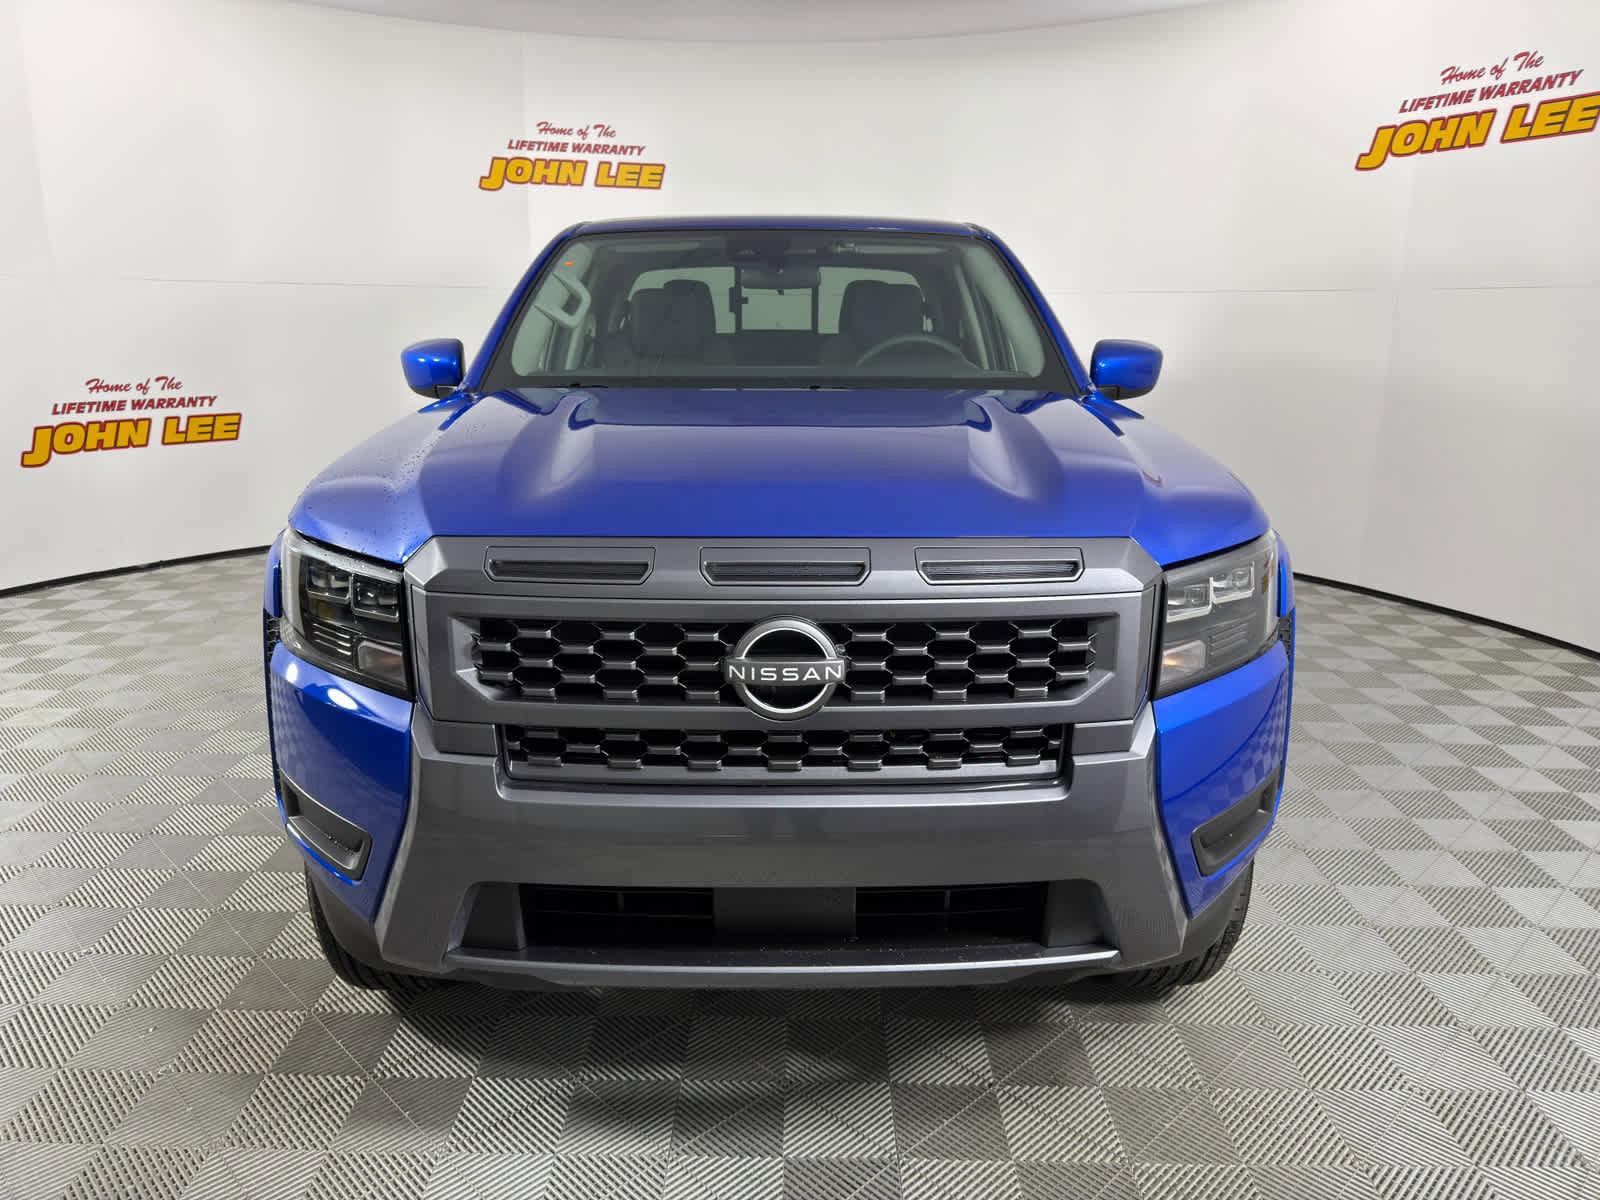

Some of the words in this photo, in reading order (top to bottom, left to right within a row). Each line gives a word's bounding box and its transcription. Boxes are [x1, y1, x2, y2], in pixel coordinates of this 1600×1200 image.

[1440, 66, 1485, 86] Home
[1489, 57, 1509, 80] of
[1513, 50, 1544, 71] The
[1399, 88, 1476, 114] LIFETIME
[1478, 69, 1584, 102] WARRANTY
[536, 121, 573, 136] Home
[577, 126, 589, 140] of
[593, 124, 616, 138] The
[1355, 108, 1497, 171] JOHN
[1500, 91, 1600, 144] LEE
[507, 139, 569, 153] LIFETIME
[572, 142, 646, 156] WARRANTY
[478, 156, 588, 191] JOHN
[594, 161, 665, 190] LEE
[85, 378, 132, 394] Home
[136, 378, 151, 395] of
[154, 376, 183, 391] The
[52, 400, 127, 415] LIFETIME
[131, 395, 217, 411] WARRANTY
[20, 418, 152, 468] JOHN
[161, 412, 242, 445] LEE
[729, 665, 841, 681] NISSAN
